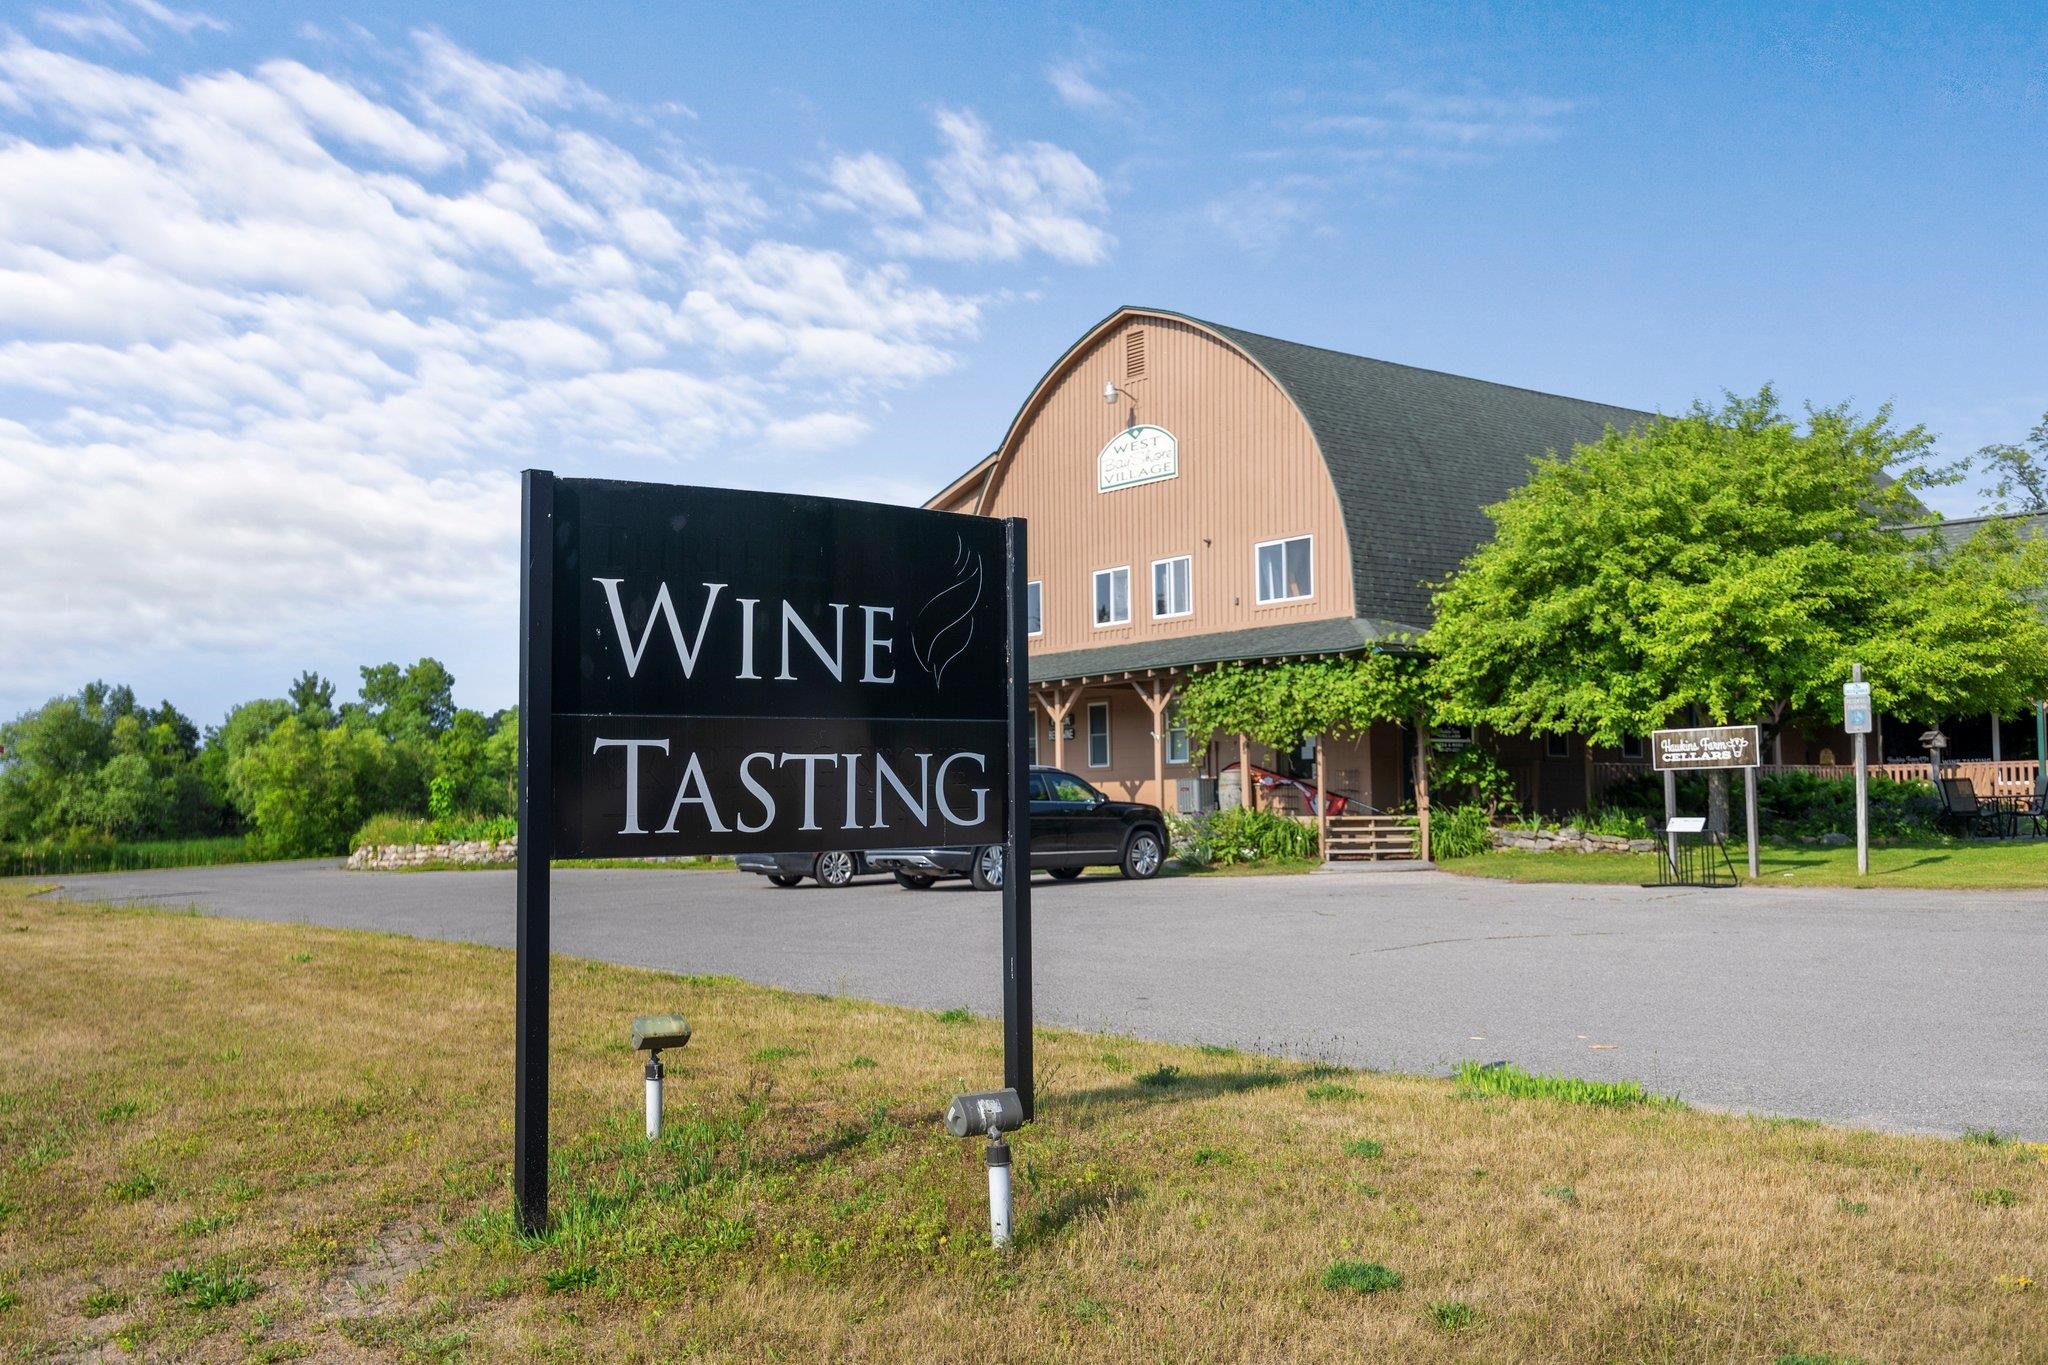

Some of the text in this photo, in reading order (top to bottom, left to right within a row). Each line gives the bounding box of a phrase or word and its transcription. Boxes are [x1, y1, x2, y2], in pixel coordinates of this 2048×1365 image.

[1113, 436, 1161, 454] WEST
[1104, 462, 1172, 484] VILLAGE
[592, 577, 896, 684] WINE
[1699, 737, 1727, 751] Farm
[1661, 751, 1732, 763] CELLARS
[592, 737, 990, 835] TASTING
